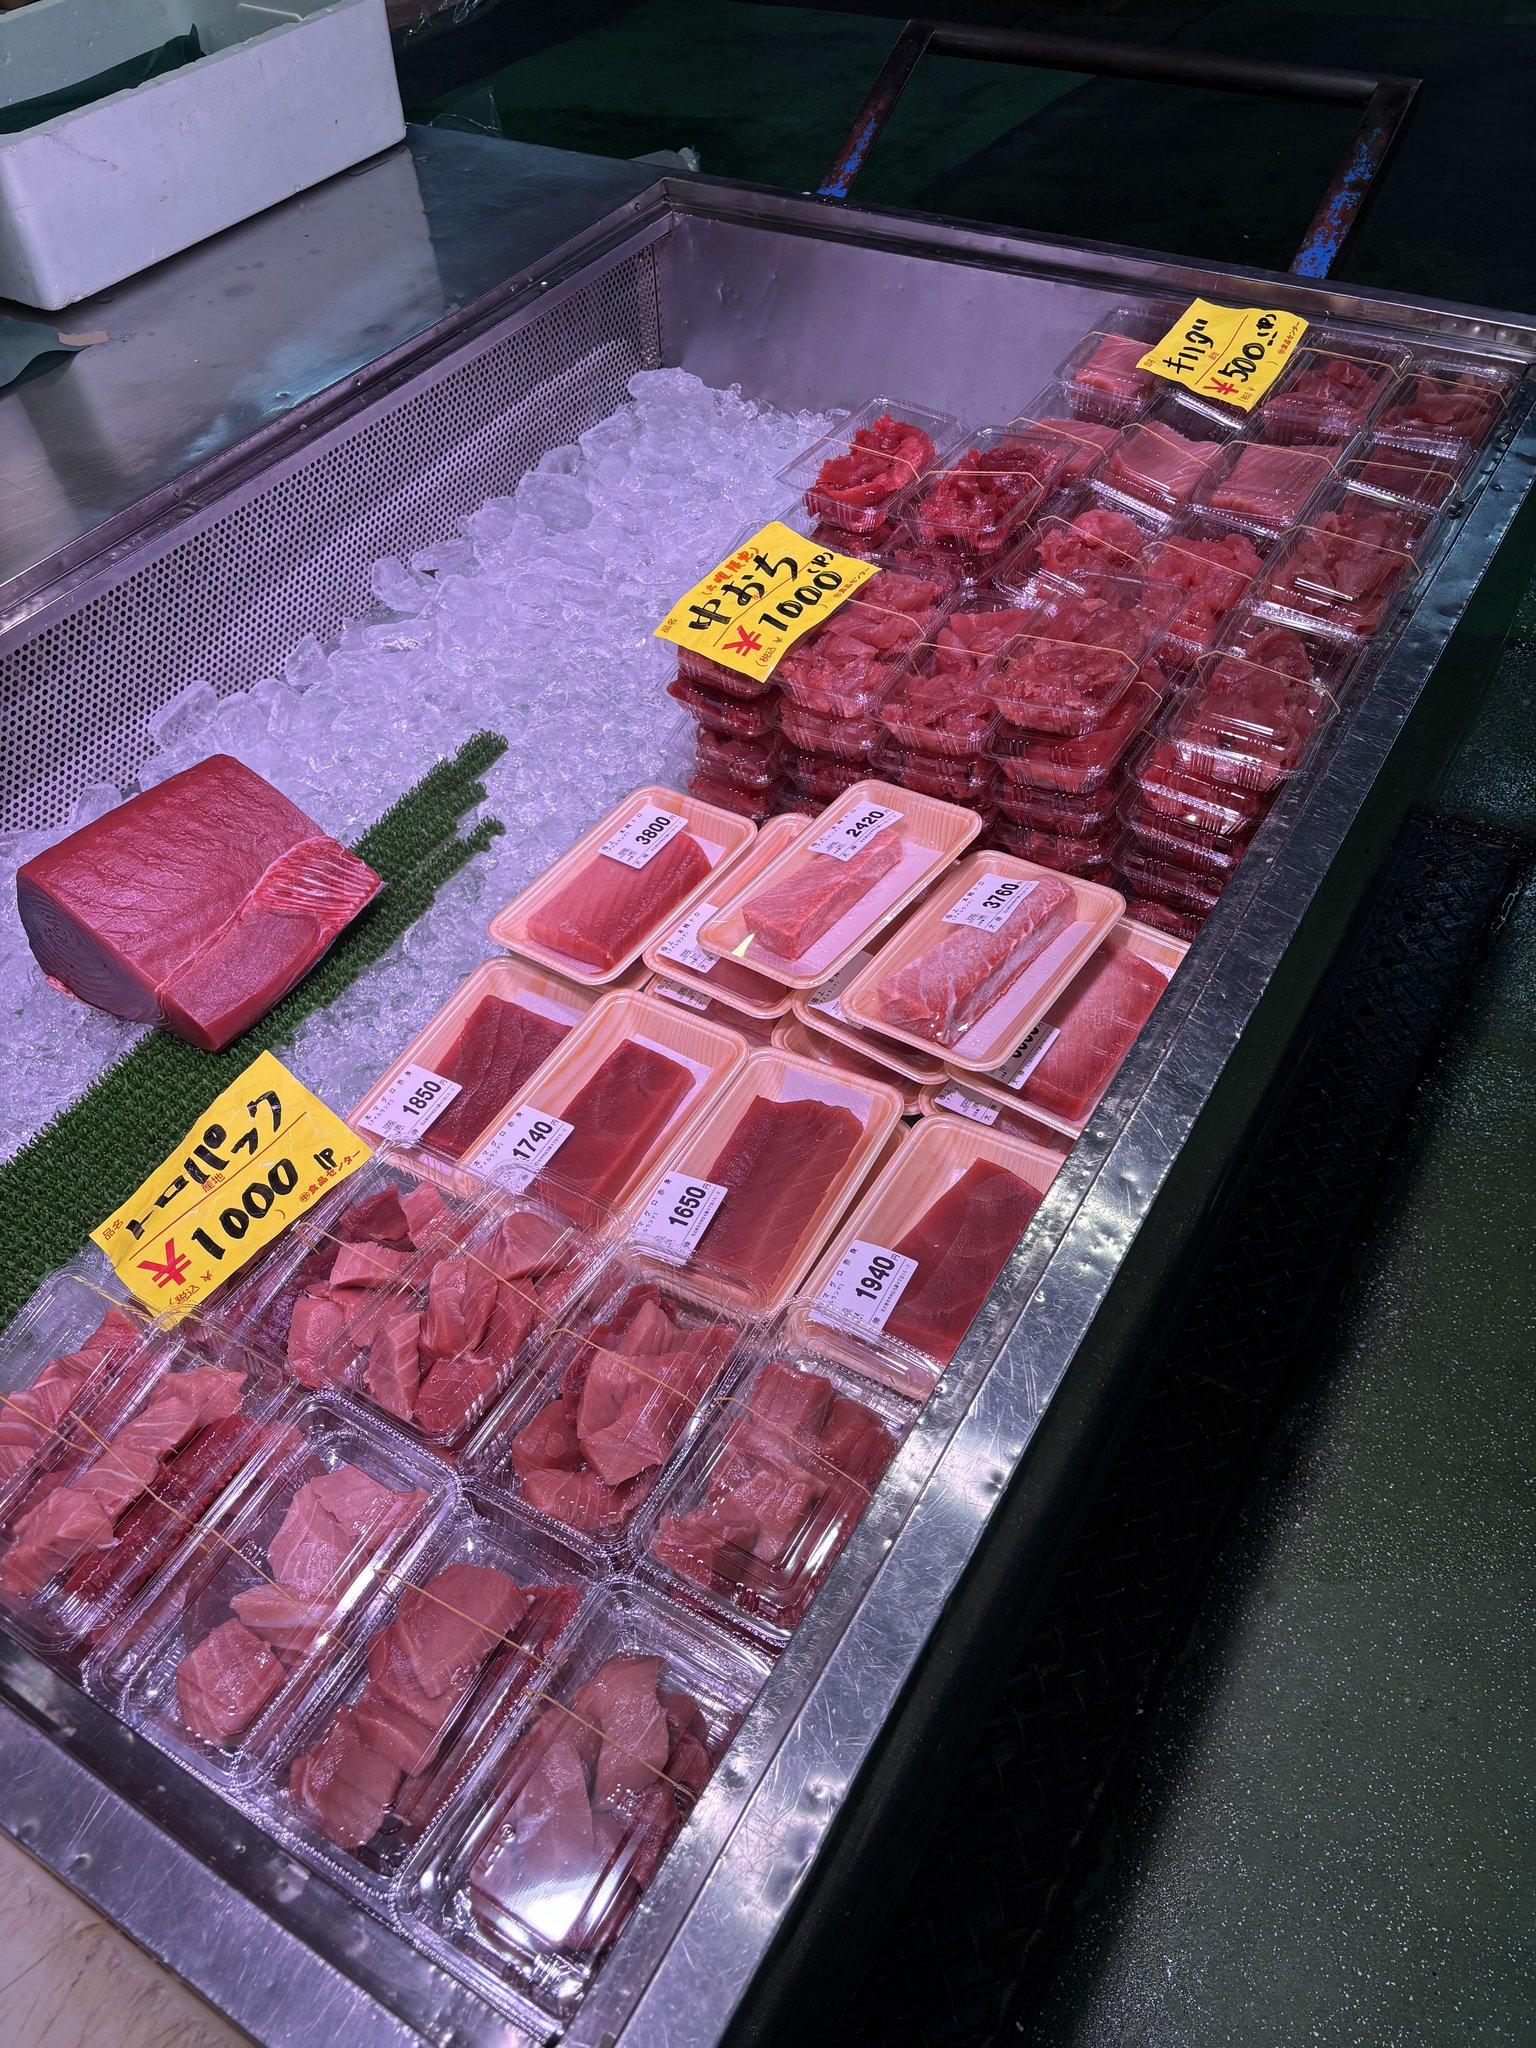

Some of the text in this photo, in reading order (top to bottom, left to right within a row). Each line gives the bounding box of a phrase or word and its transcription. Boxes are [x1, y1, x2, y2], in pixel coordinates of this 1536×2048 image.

[688, 552, 798, 630] 中おち
[125, 1090, 282, 1240] トロパック
[201, 1173, 226, 1193] 産地
[637, 1179, 672, 1227] マグロ赤身
[102, 1218, 124, 1241] 品名
[822, 1248, 858, 1299] マグロ赤身
